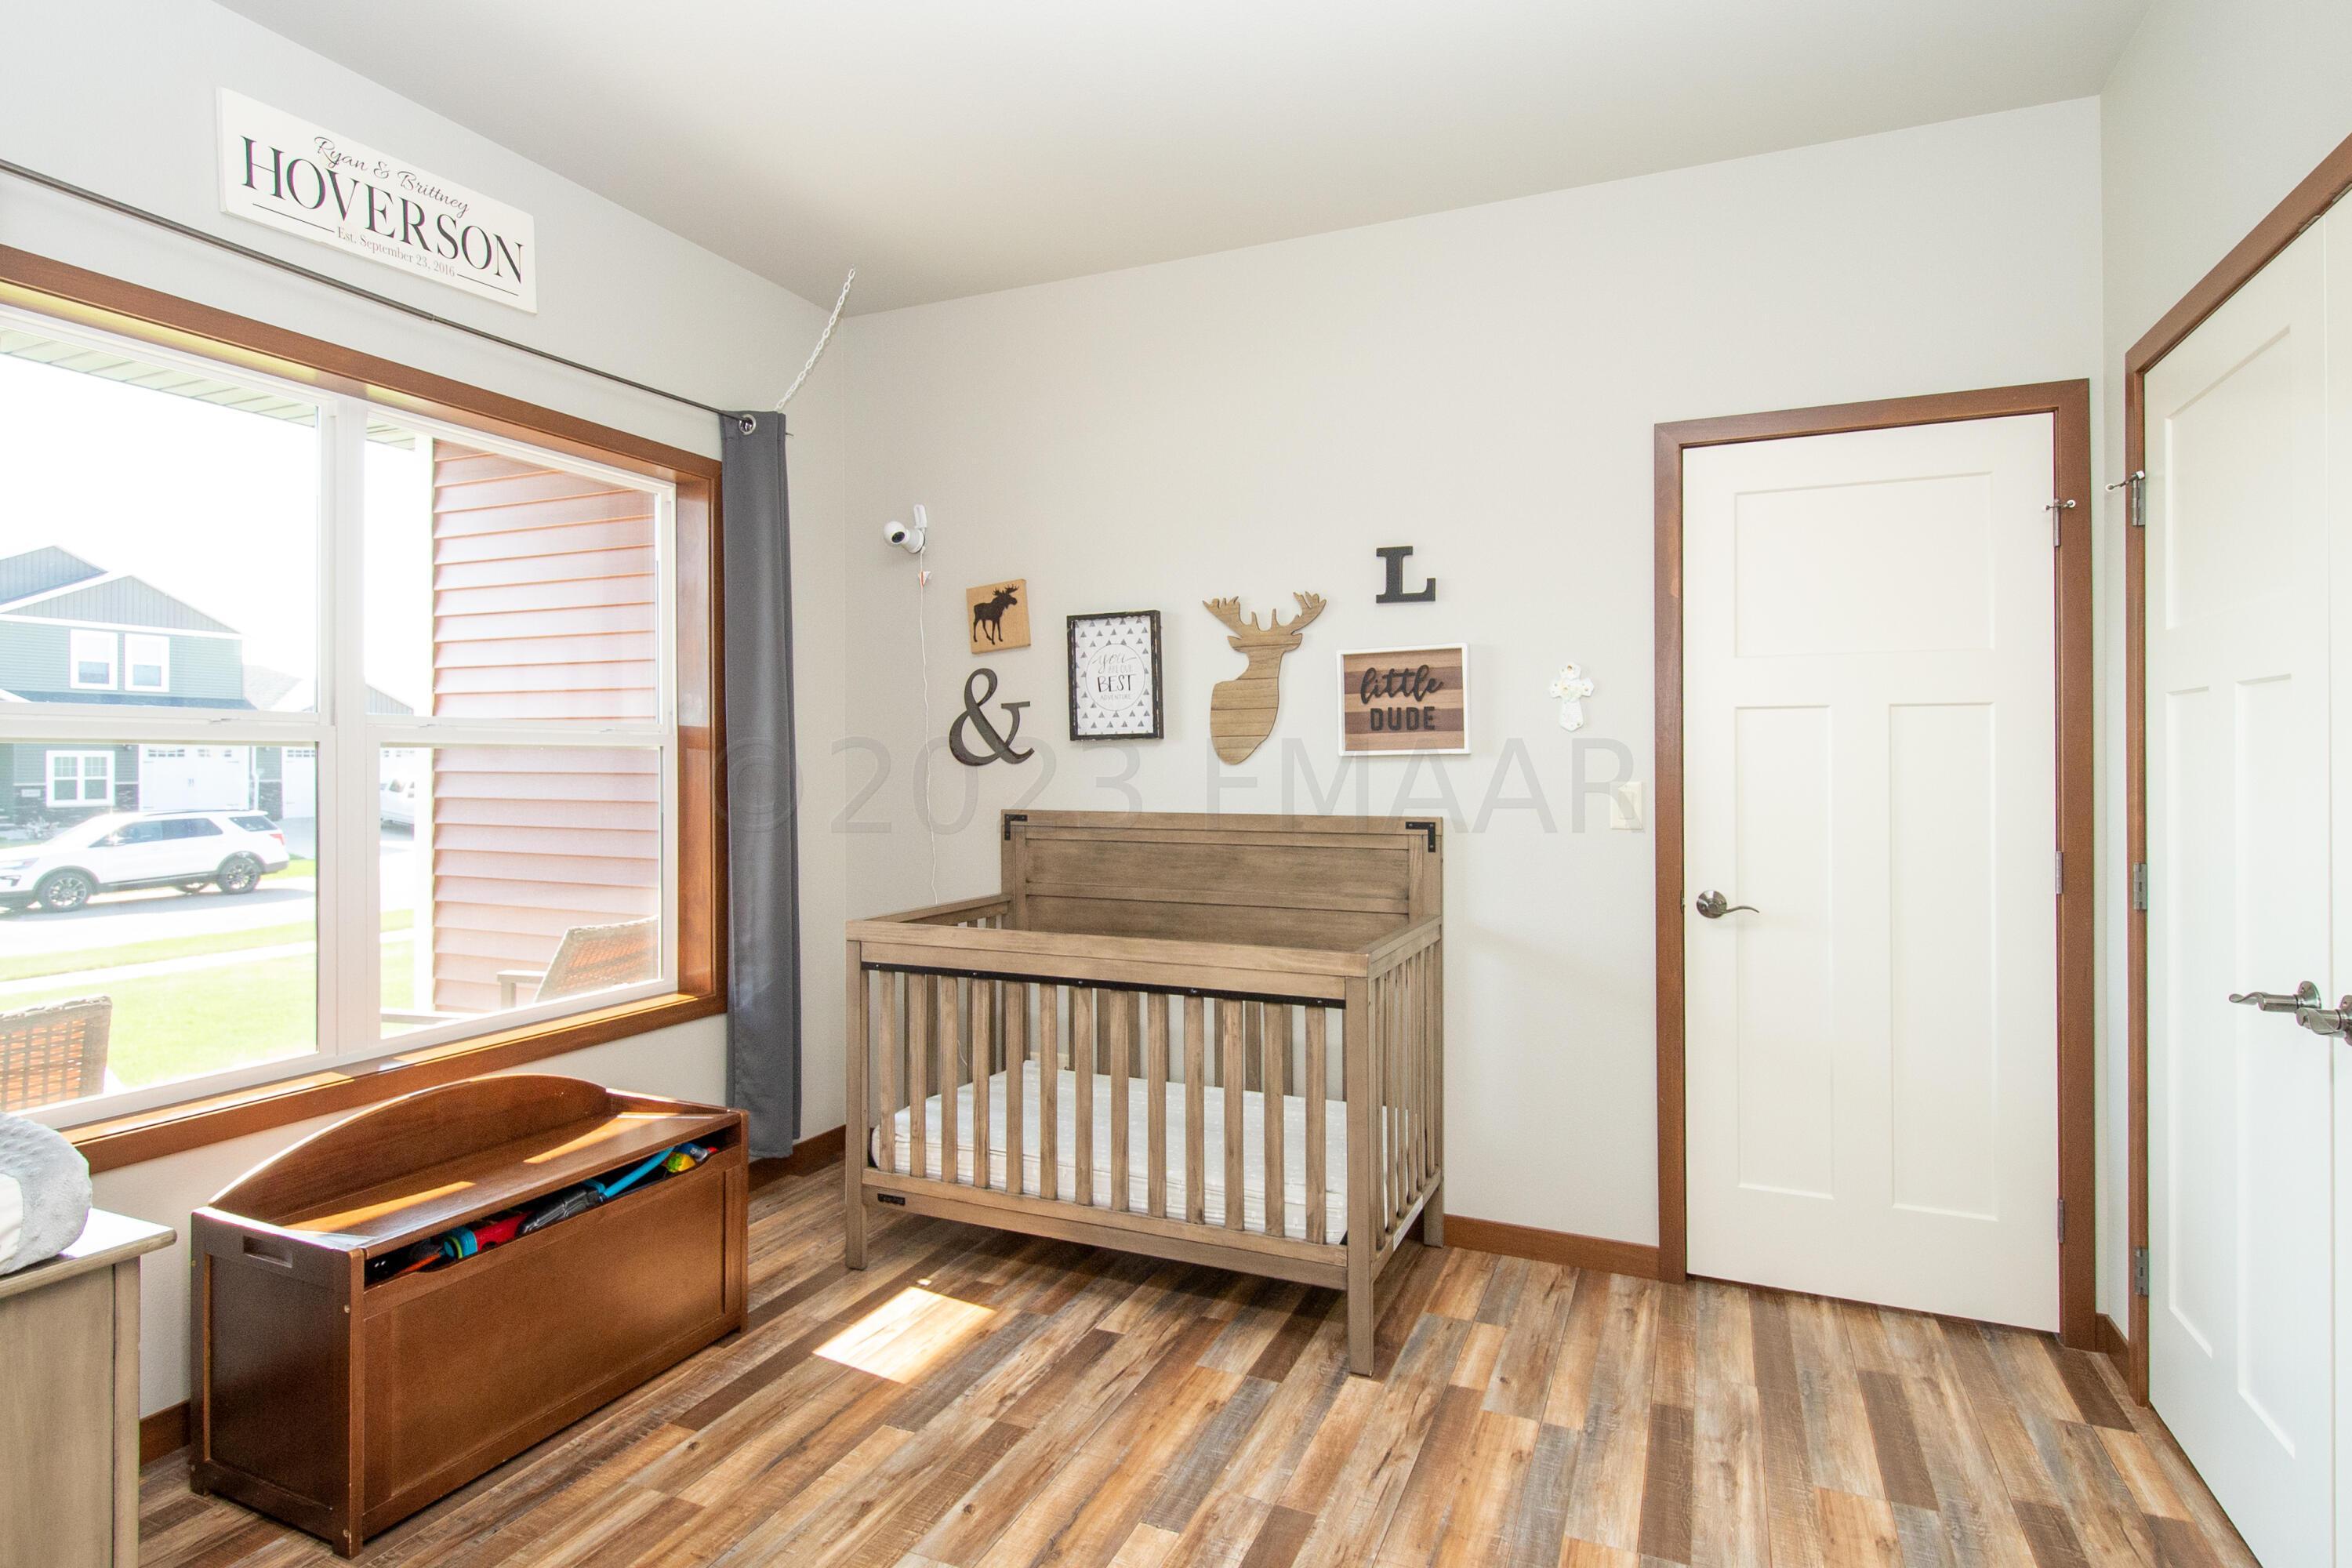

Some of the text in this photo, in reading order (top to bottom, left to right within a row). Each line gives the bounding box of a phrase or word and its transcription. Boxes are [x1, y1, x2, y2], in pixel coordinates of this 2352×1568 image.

[314, 136, 470, 219] Ryan & Brittney
[240, 135, 524, 284] HOVERSON
[338, 226, 456, 277] Est. September 23, 2016
[1375, 546, 1436, 604] L
[1098, 673, 1137, 693] BEST
[1360, 664, 1444, 704] little
[949, 668, 1035, 766] &
[1370, 706, 1436, 731] DUDE
